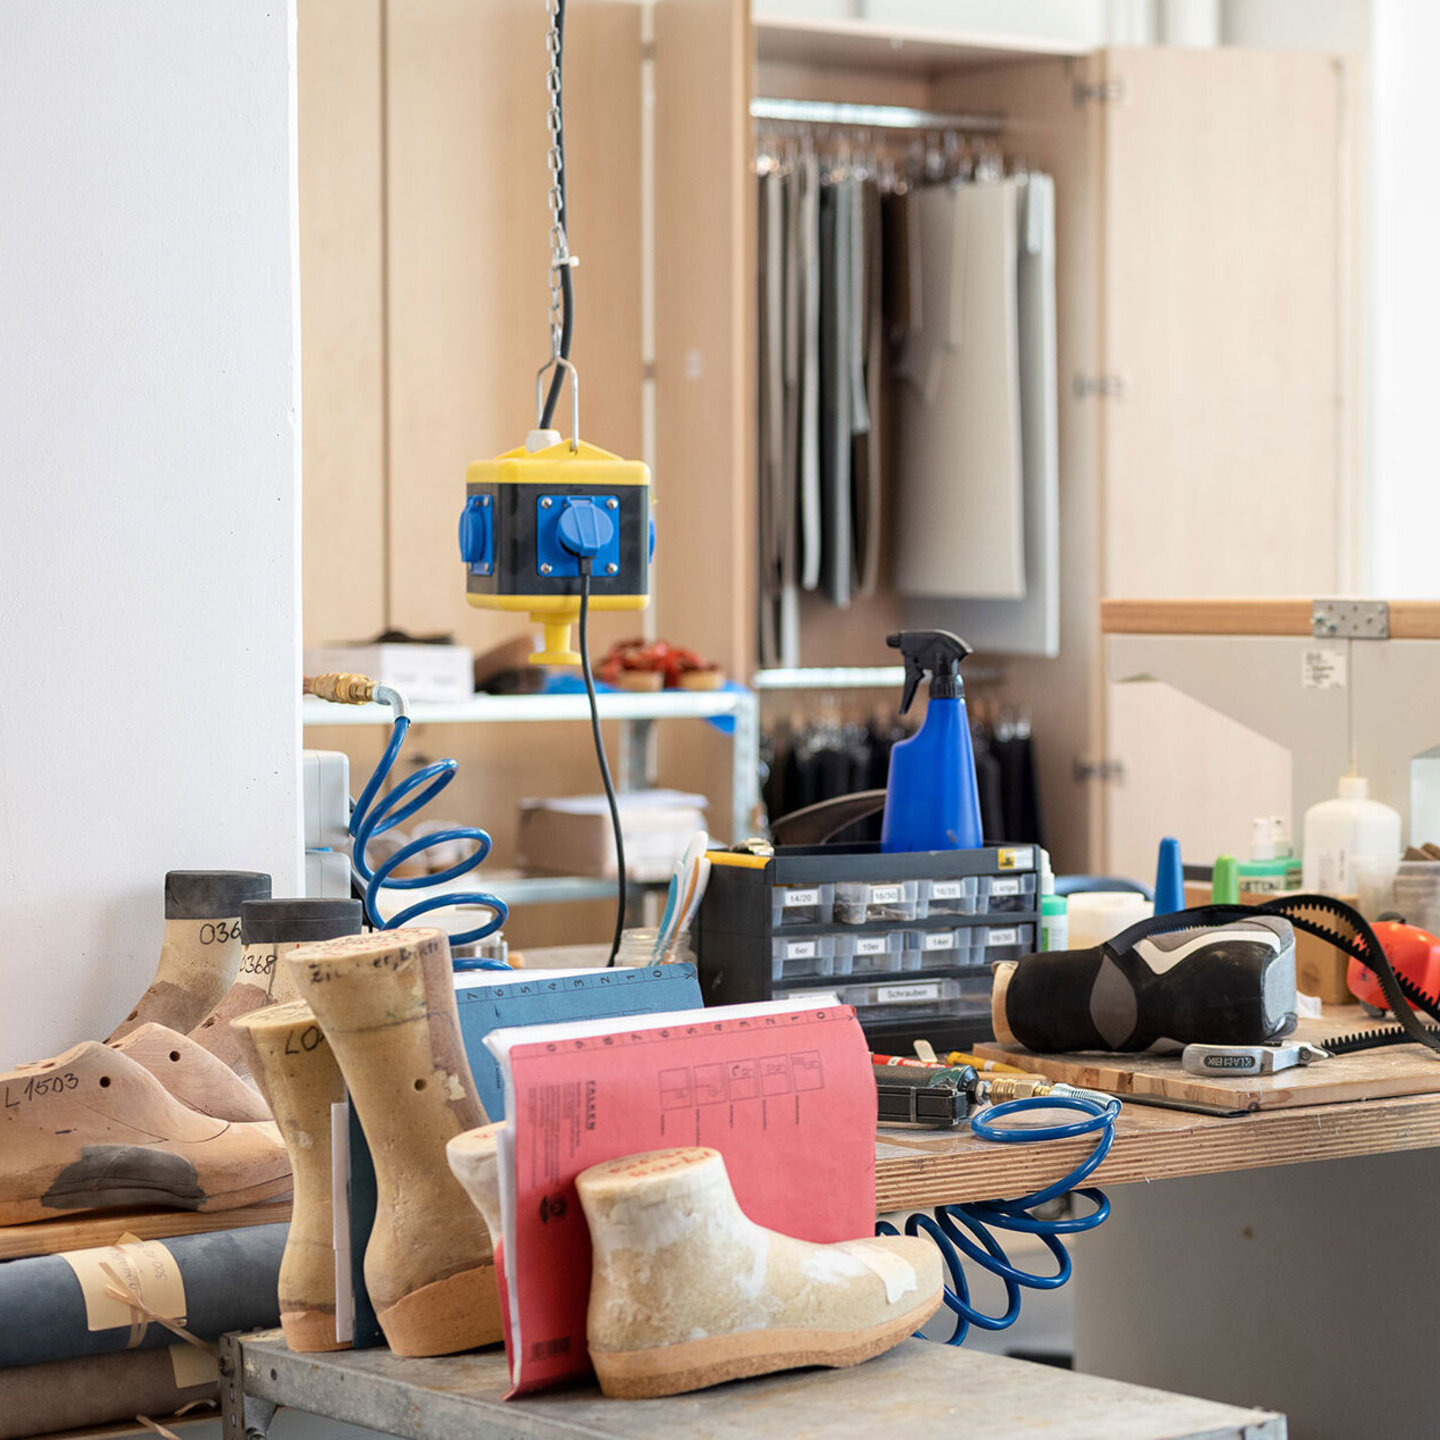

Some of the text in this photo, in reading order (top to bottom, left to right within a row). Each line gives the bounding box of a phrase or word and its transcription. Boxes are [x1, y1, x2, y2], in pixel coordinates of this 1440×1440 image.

[886, 988, 929, 999] Schrauben
[284, 1025, 325, 1056] LO
[5, 1073, 79, 1108] L 1503
[586, 1080, 597, 1131] FALKEN
